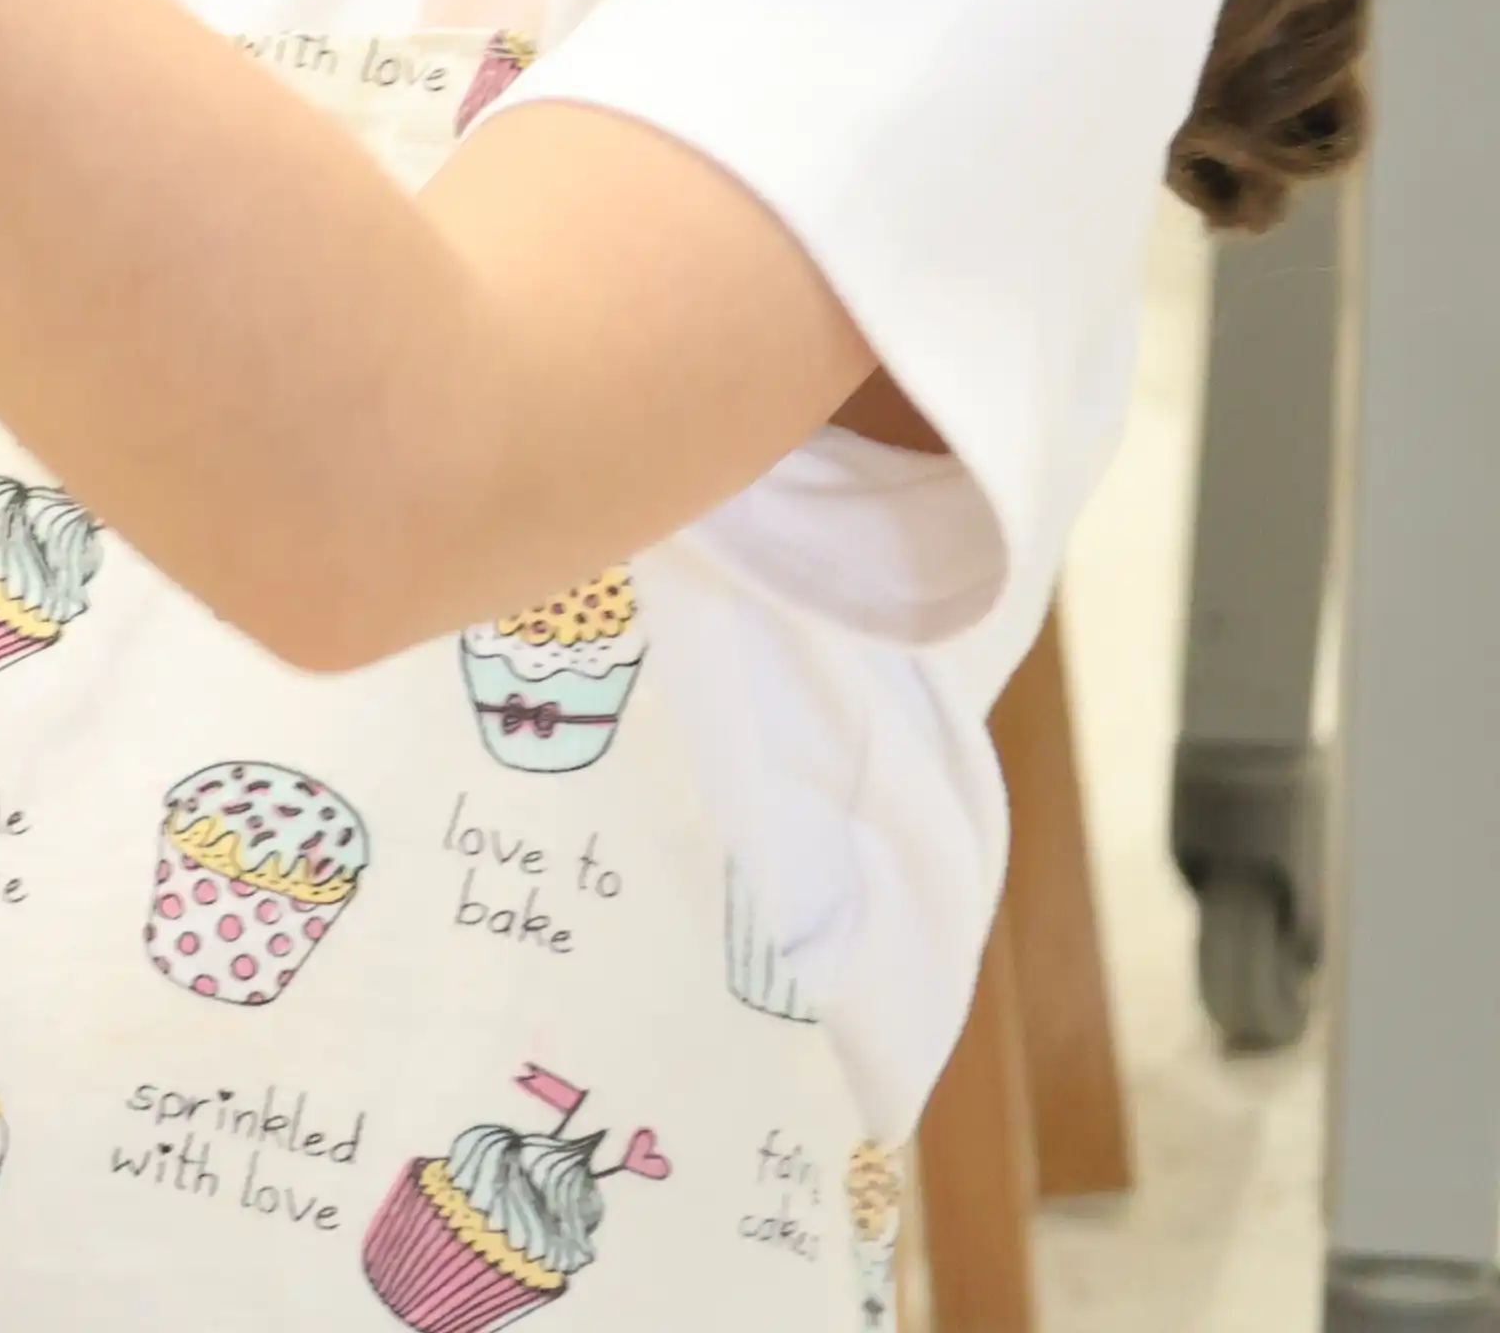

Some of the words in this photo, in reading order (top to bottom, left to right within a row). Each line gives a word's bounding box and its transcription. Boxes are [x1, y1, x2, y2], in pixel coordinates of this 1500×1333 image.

[359, 36, 450, 93] love
[442, 790, 548, 875] love
[577, 831, 624, 899] to
[453, 866, 575, 954] bake
[125, 1083, 368, 1165] sprinkled
[109, 1132, 220, 1198] with
[239, 1149, 342, 1231] love
